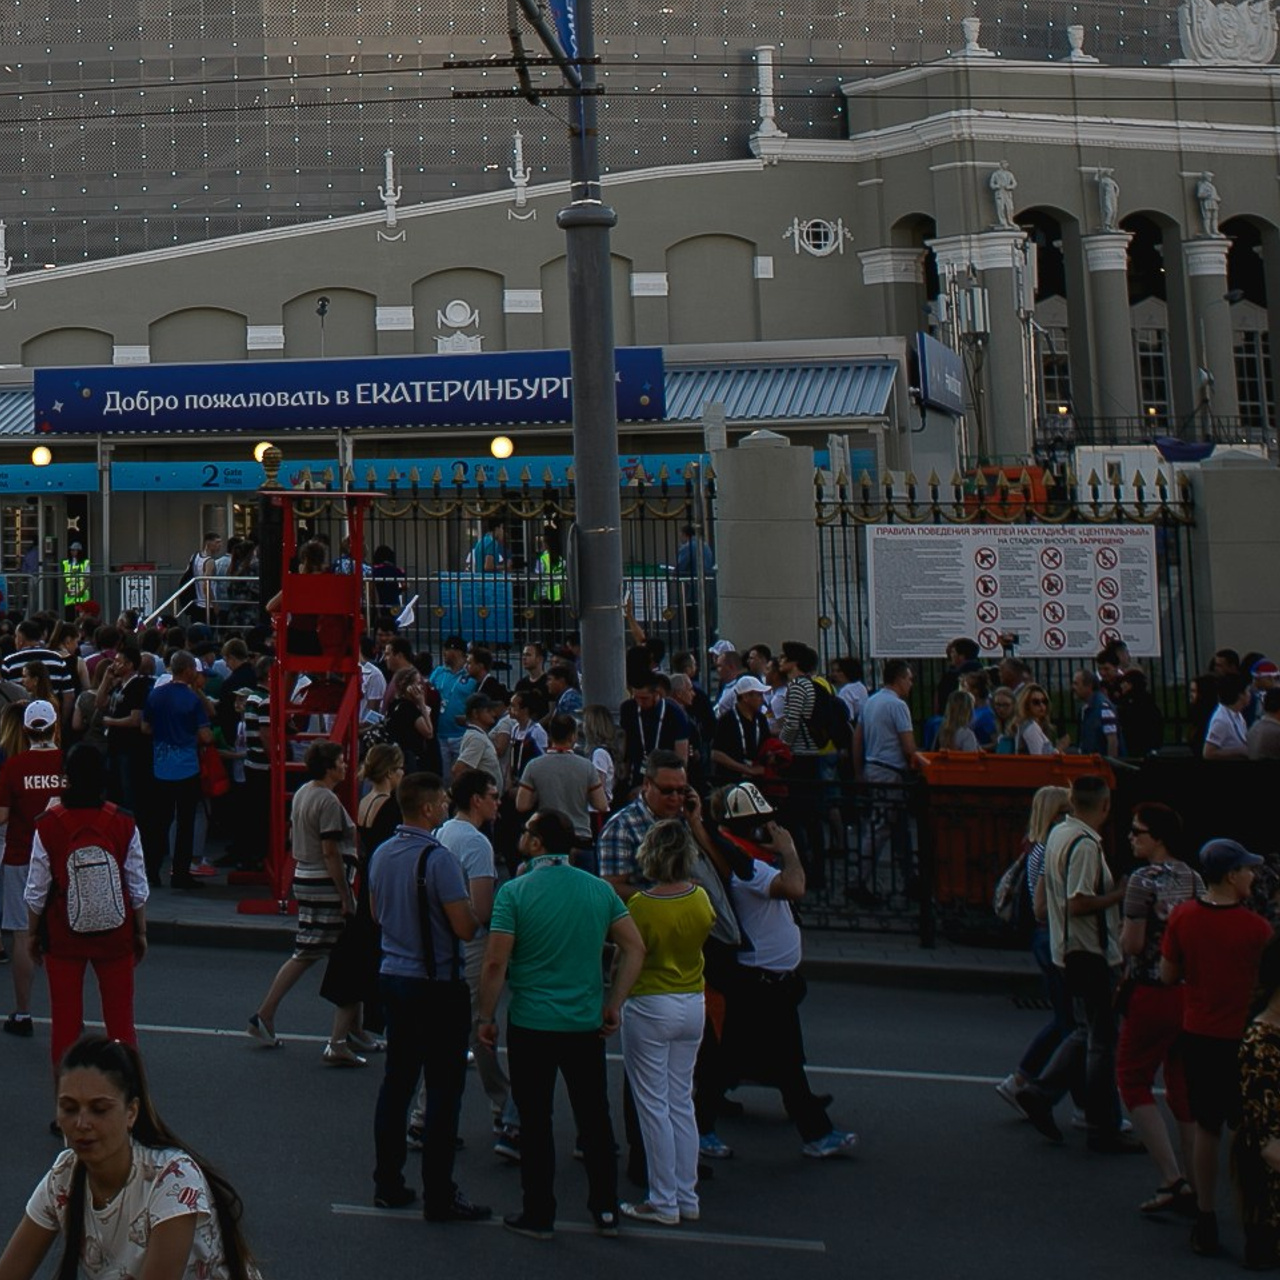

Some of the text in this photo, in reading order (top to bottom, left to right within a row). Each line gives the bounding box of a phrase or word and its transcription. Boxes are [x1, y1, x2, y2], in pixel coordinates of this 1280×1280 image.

[103, 377, 573, 417] Добро пожаловать в ЕКАТЕРИНБУРГ
[202, 464, 220, 487] 2
[223, 467, 243, 476] Gate
[876, 527, 915, 535] ПРАВИЛА
[917, 527, 970, 536] ПОВЕДЕНИЯ
[971, 526, 1016, 535] ЗРИТЕЛЕЙ
[1017, 528, 1029, 536] НА
[1030, 528, 1076, 537] СТАДИОНЕ
